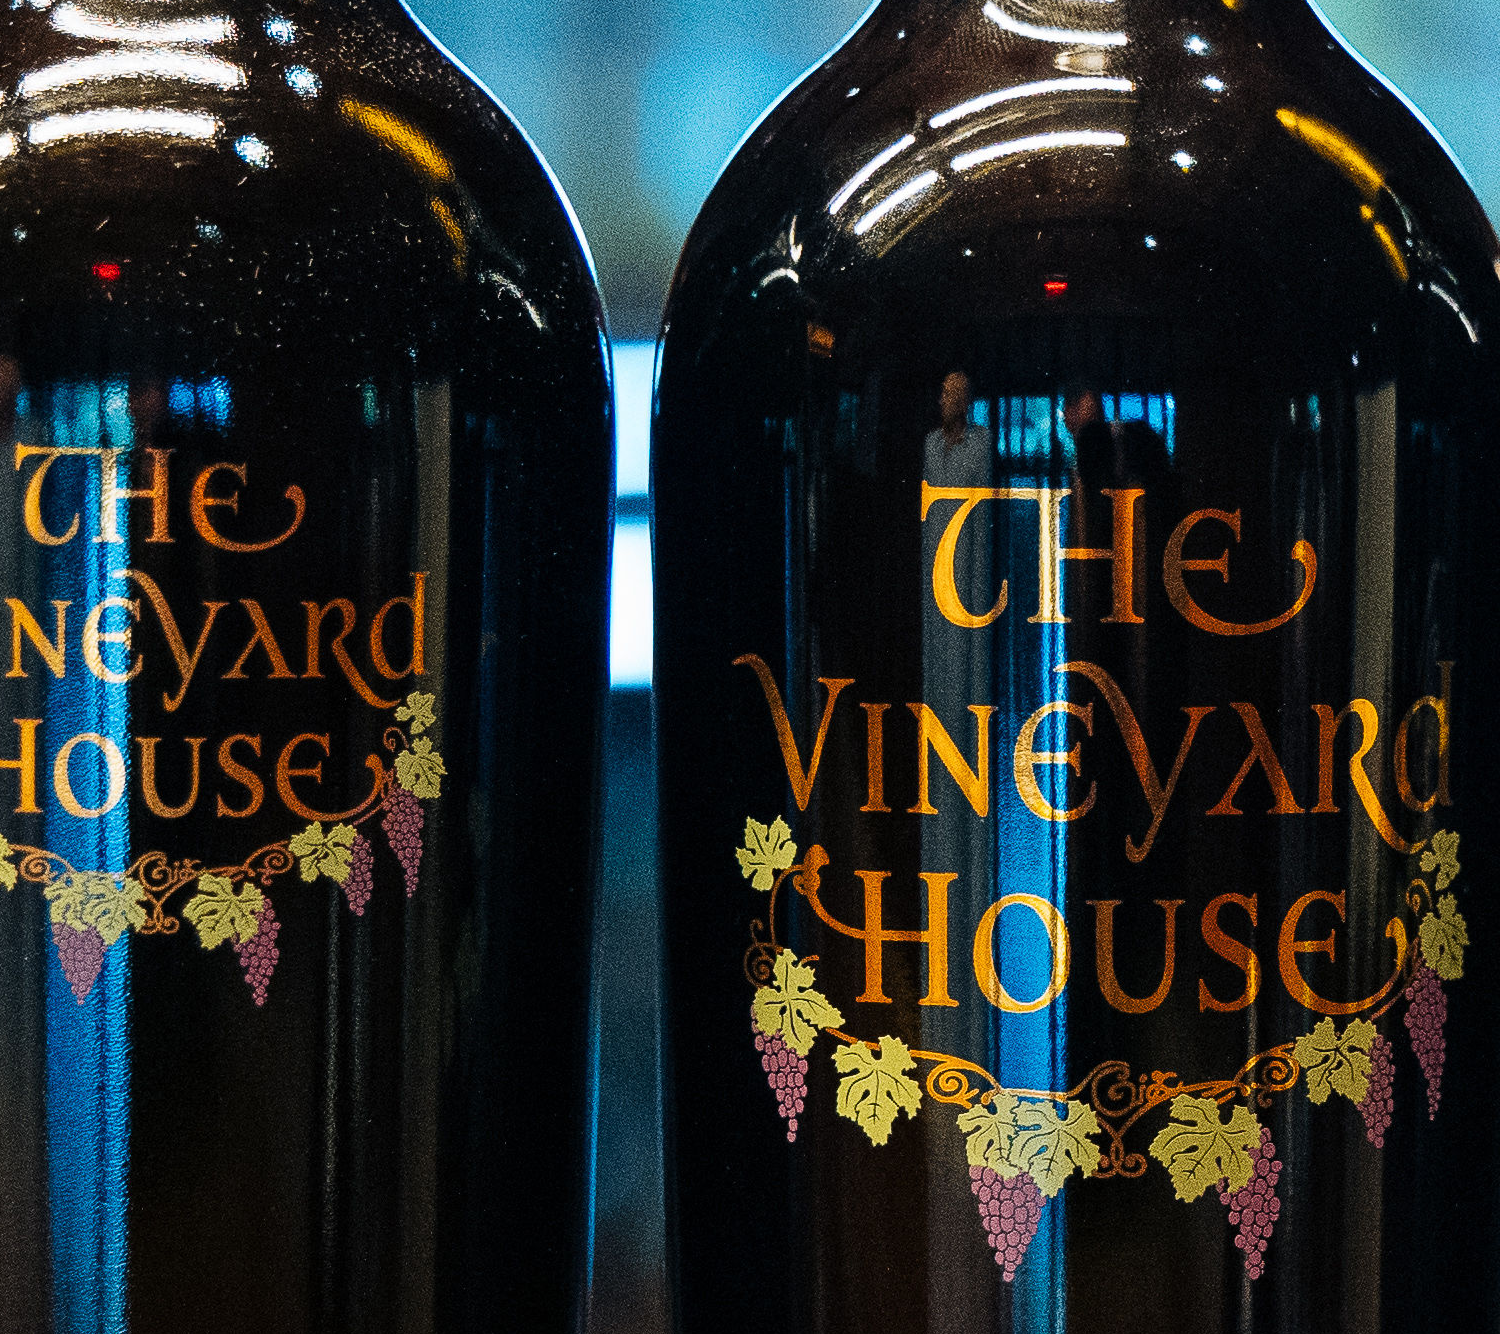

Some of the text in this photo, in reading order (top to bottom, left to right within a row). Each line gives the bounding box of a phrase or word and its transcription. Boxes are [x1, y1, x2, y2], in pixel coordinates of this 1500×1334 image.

[14, 442, 306, 552] THE
[919, 478, 1318, 636] THE
[731, 652, 1457, 864] VINEYARD
[793, 843, 1408, 1015] HOUSE
